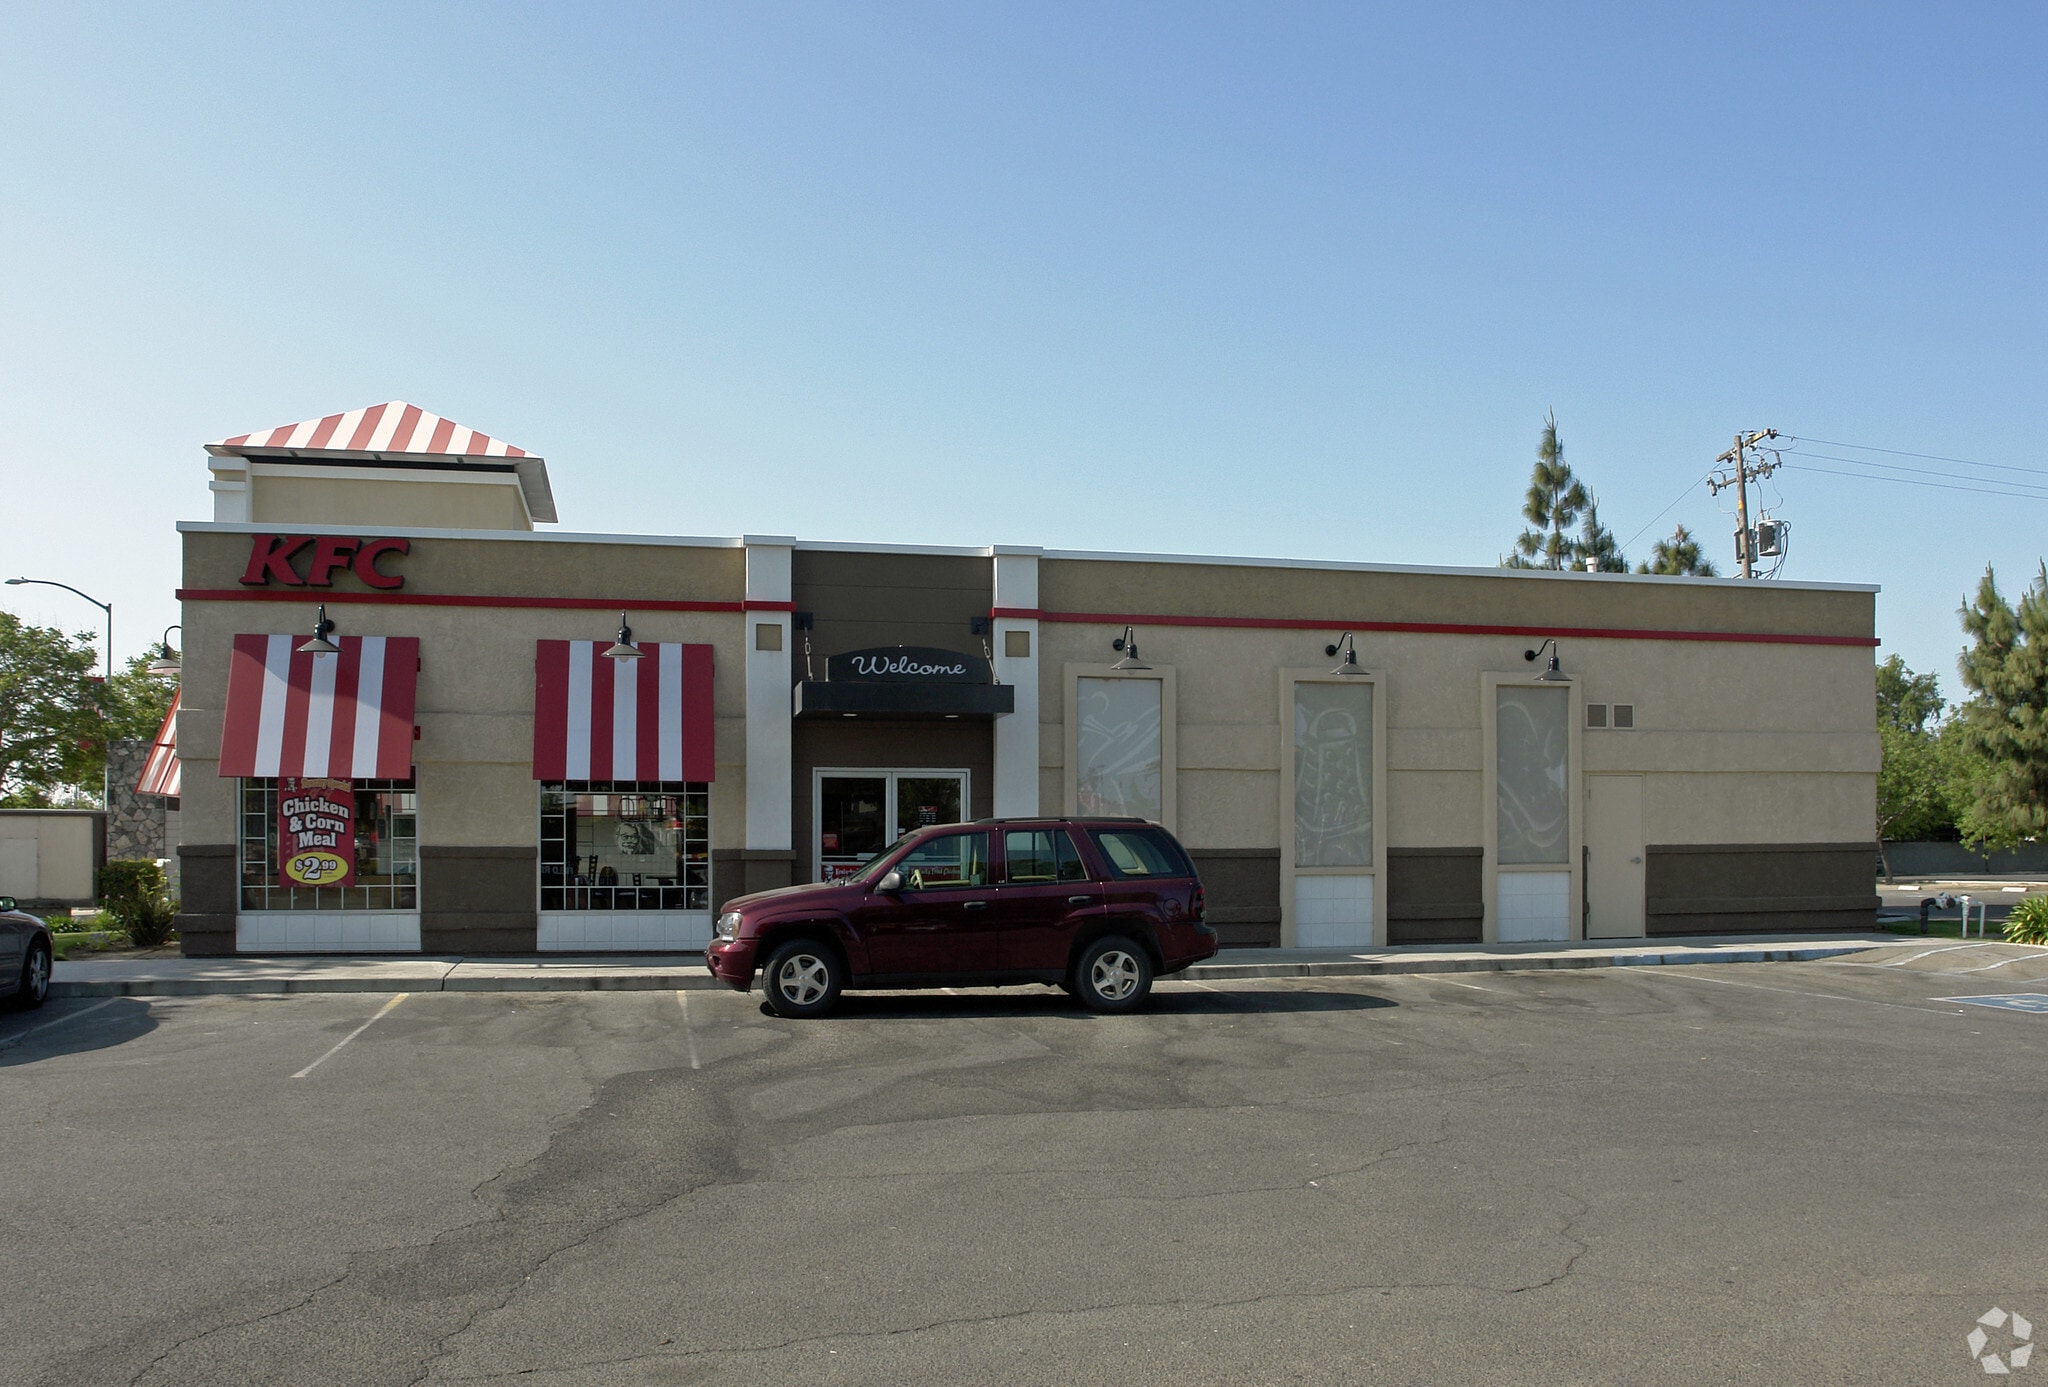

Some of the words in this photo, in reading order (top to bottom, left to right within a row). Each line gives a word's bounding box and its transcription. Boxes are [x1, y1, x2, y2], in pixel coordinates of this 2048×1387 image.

[239, 534, 411, 589] KFC
[851, 655, 967, 675] Welcome
[282, 796, 349, 819] Chicken
[289, 816, 302, 833] &
[305, 813, 345, 833] Corn
[299, 832, 337, 848] Meal
